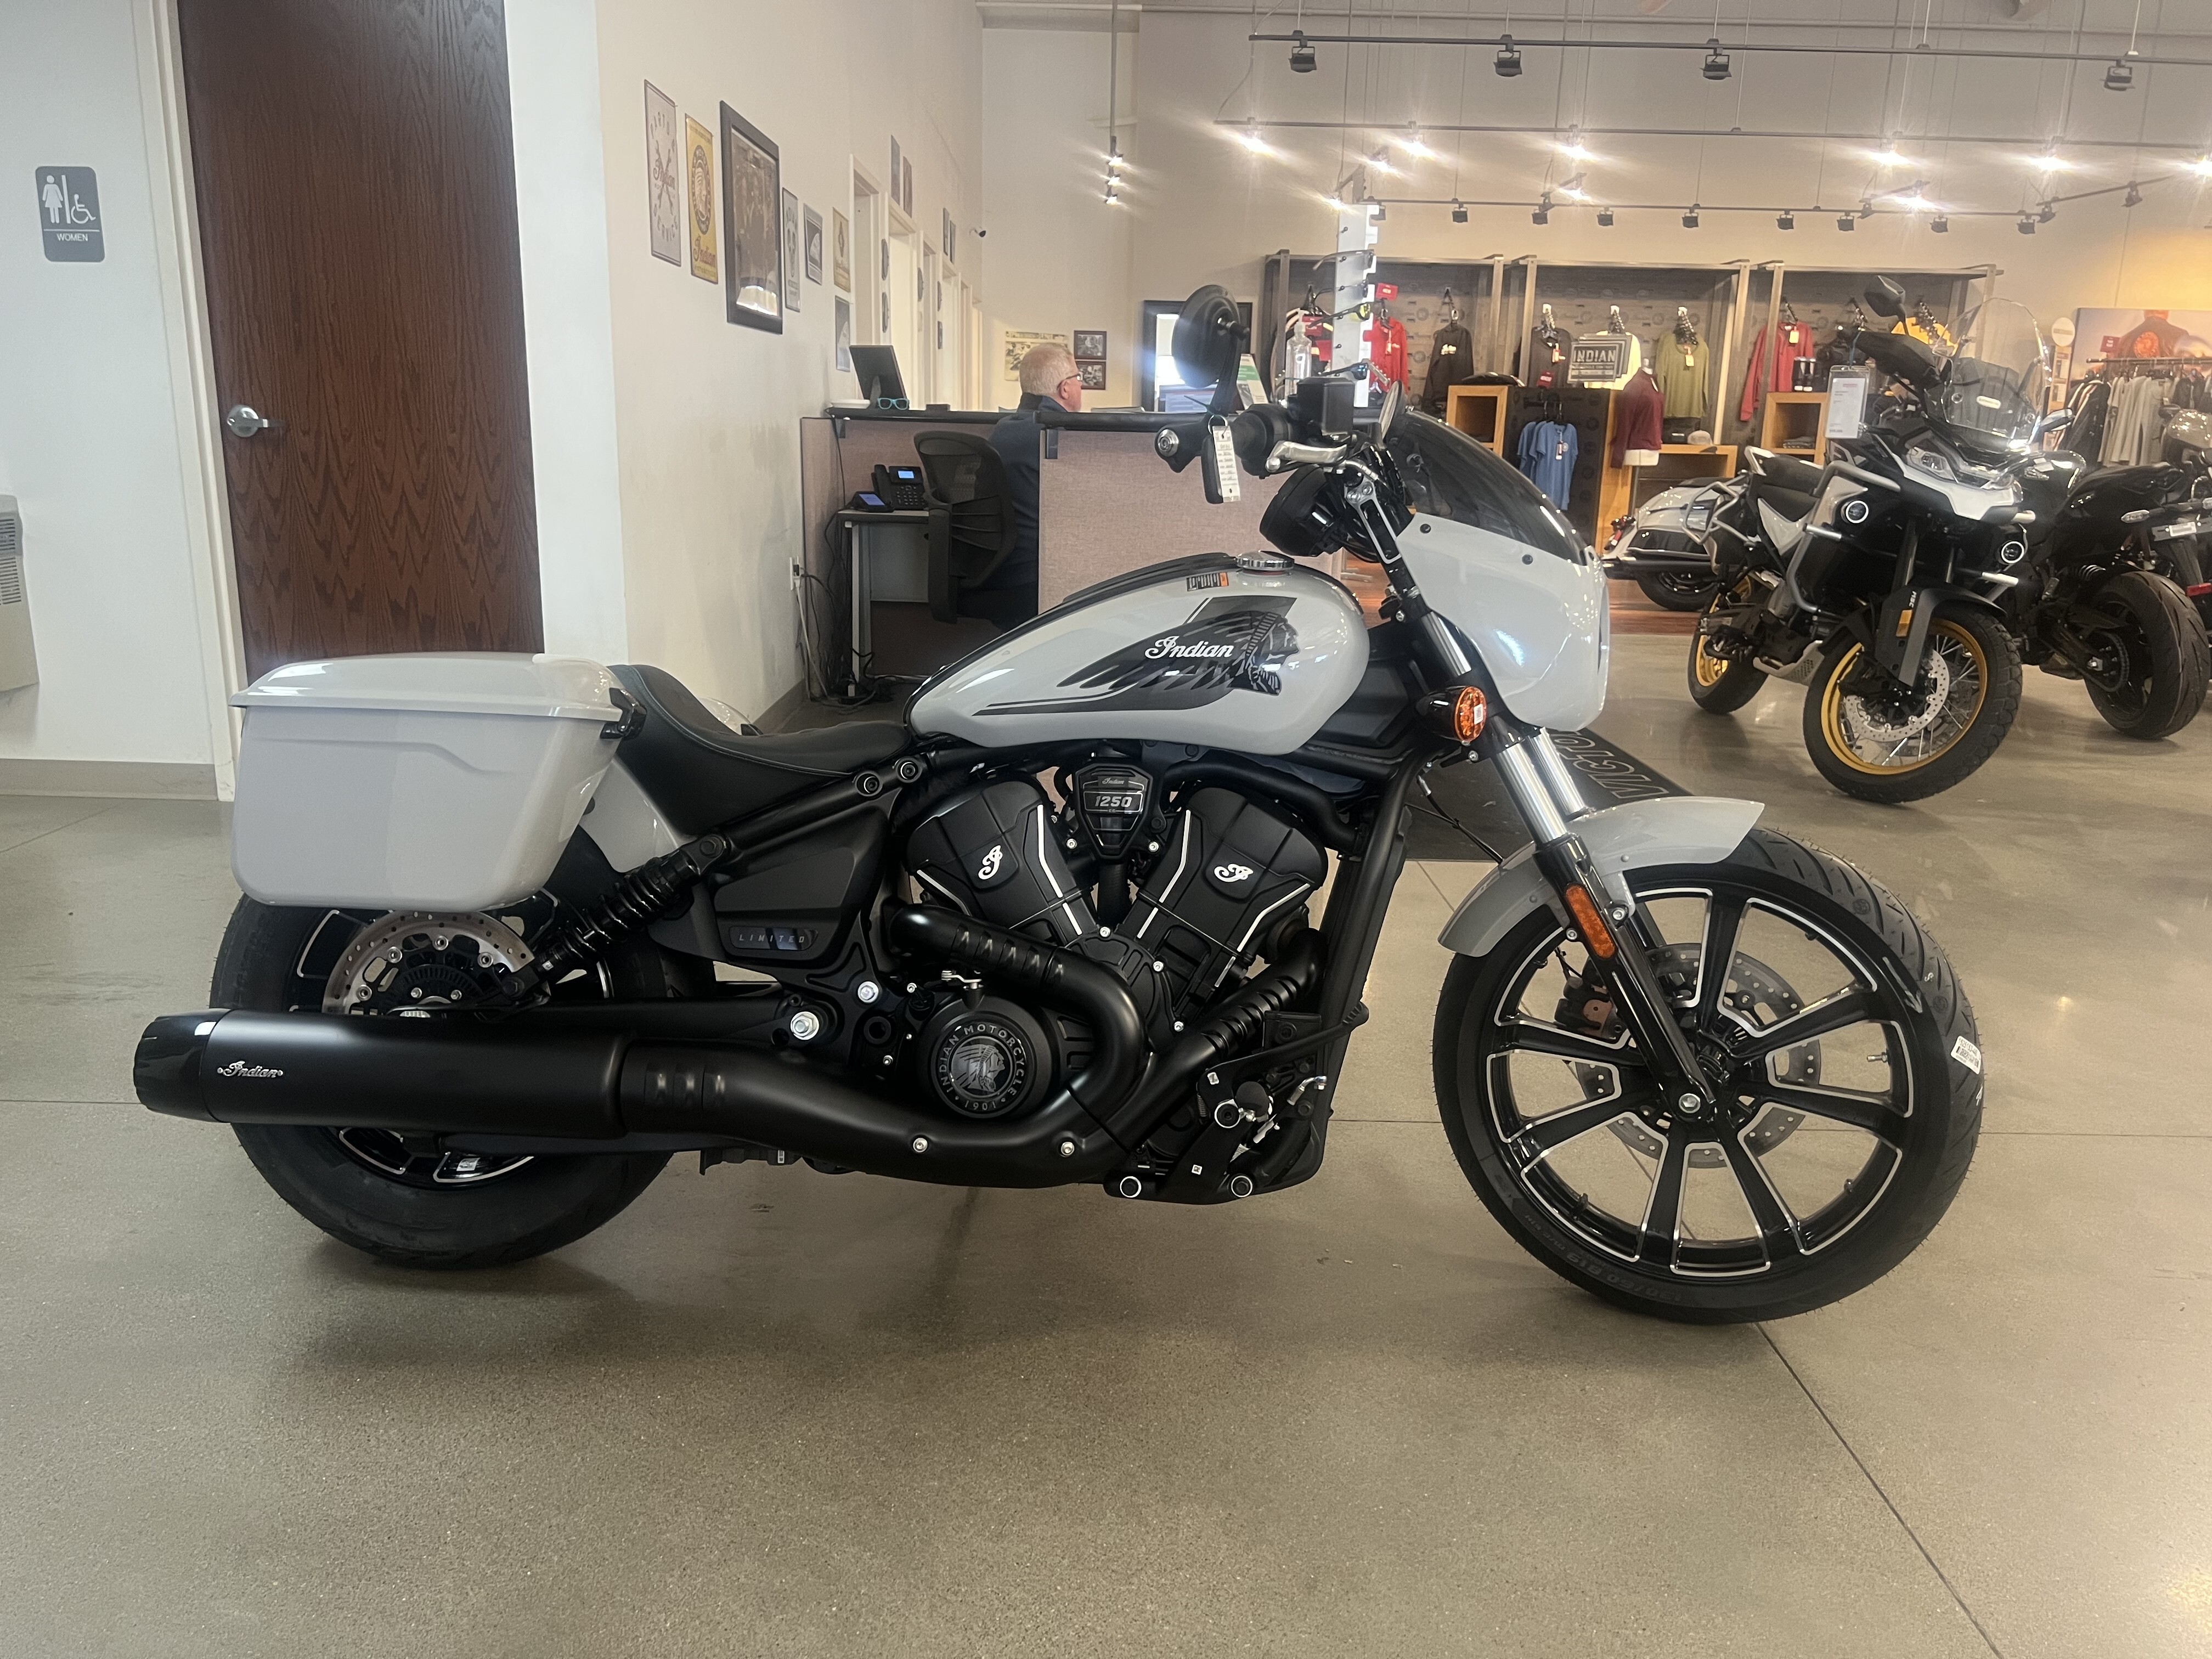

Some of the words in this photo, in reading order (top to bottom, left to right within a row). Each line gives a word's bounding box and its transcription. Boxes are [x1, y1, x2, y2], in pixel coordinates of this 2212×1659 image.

[57, 233, 88, 241] WOMEN
[1573, 349, 1616, 362] INDIAN
[1144, 635, 1235, 659] Indian
[1094, 795, 1132, 808] 1250
[738, 934, 805, 943] LIMITED
[939, 1034, 960, 1092] INDIAN
[963, 1024, 1025, 1096] MOTORCYCLE
[222, 1060, 278, 1078] Indian
[964, 1100, 996, 1111] 1901
